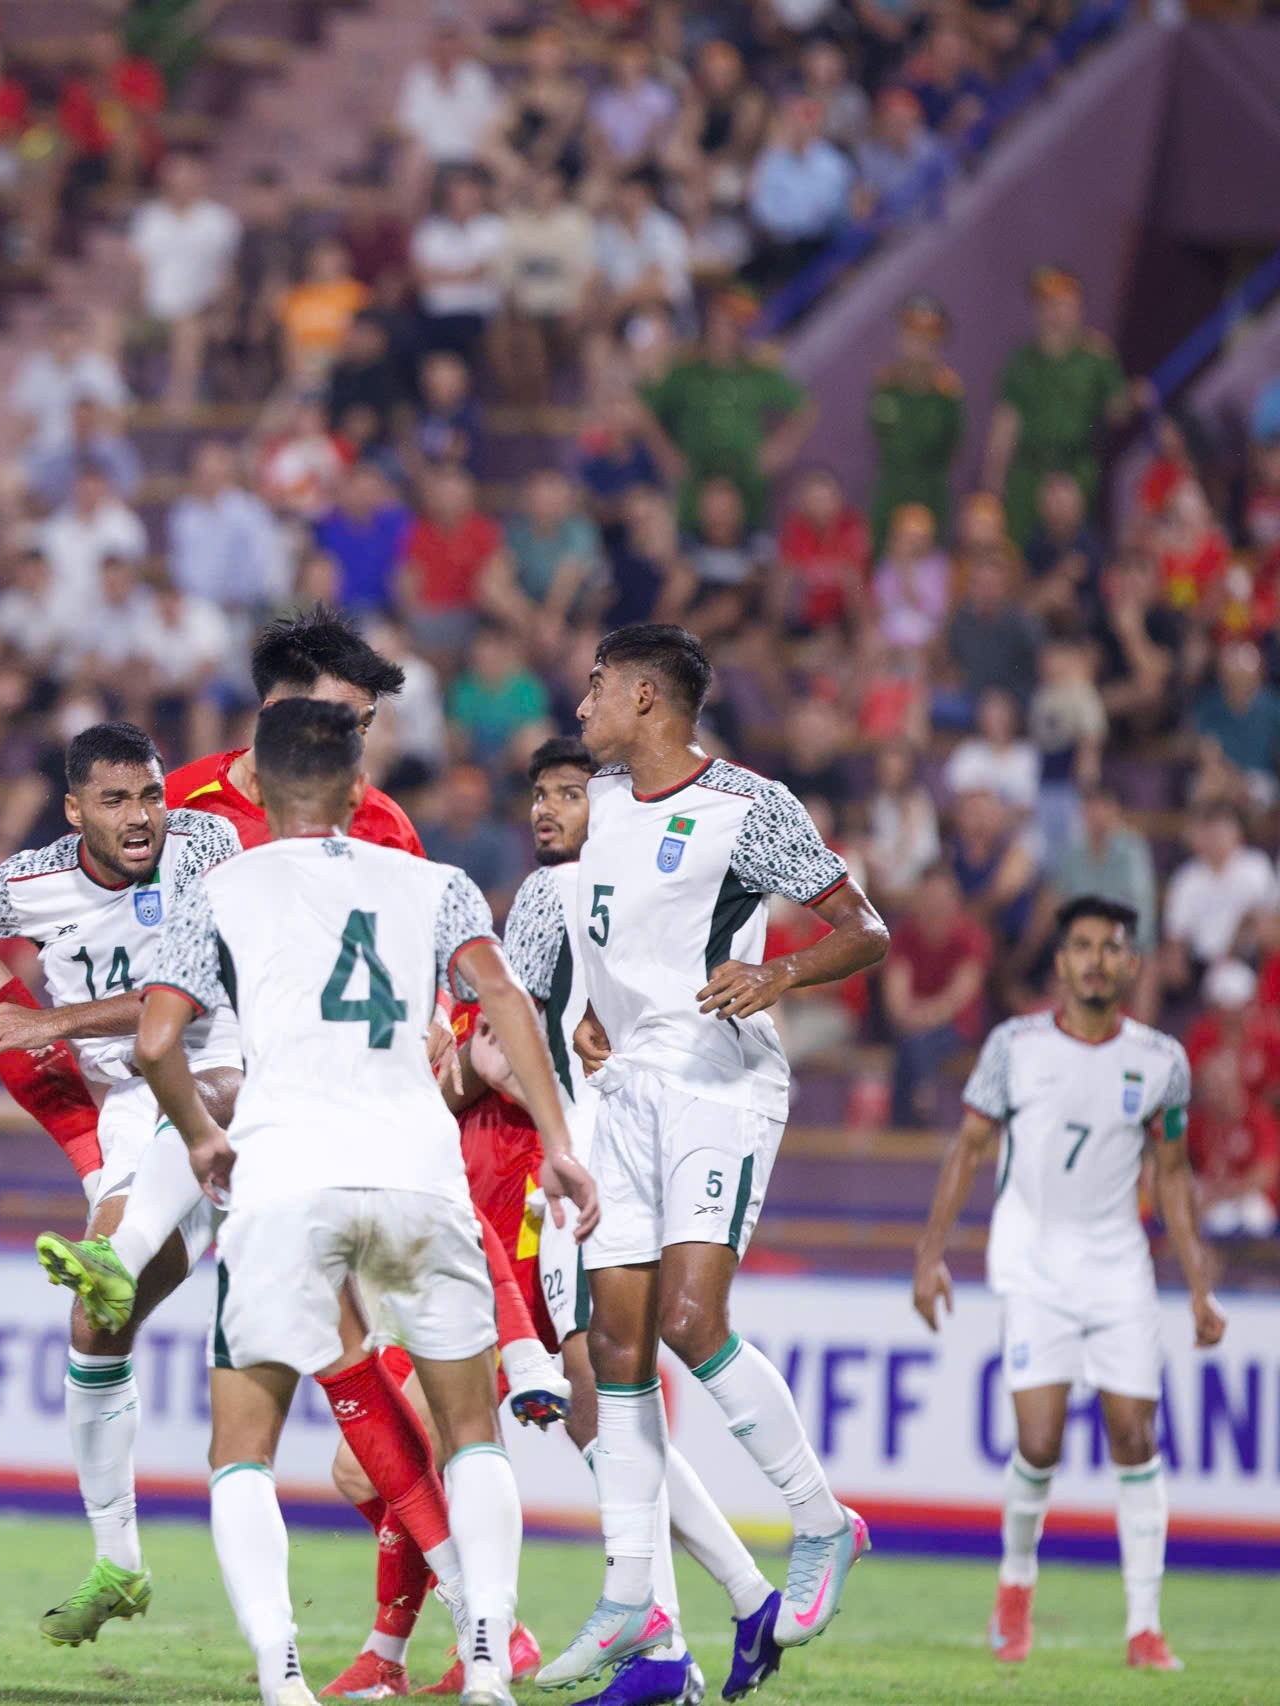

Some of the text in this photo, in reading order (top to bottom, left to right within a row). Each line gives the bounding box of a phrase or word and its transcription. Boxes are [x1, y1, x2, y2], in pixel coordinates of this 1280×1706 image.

[588, 884, 615, 948] 5
[68, 946, 136, 1000] 14
[320, 909, 407, 1050] 4
[1065, 1121, 1091, 1173] 7
[706, 1169, 723, 1199] 5
[543, 1268, 565, 1301] 22
